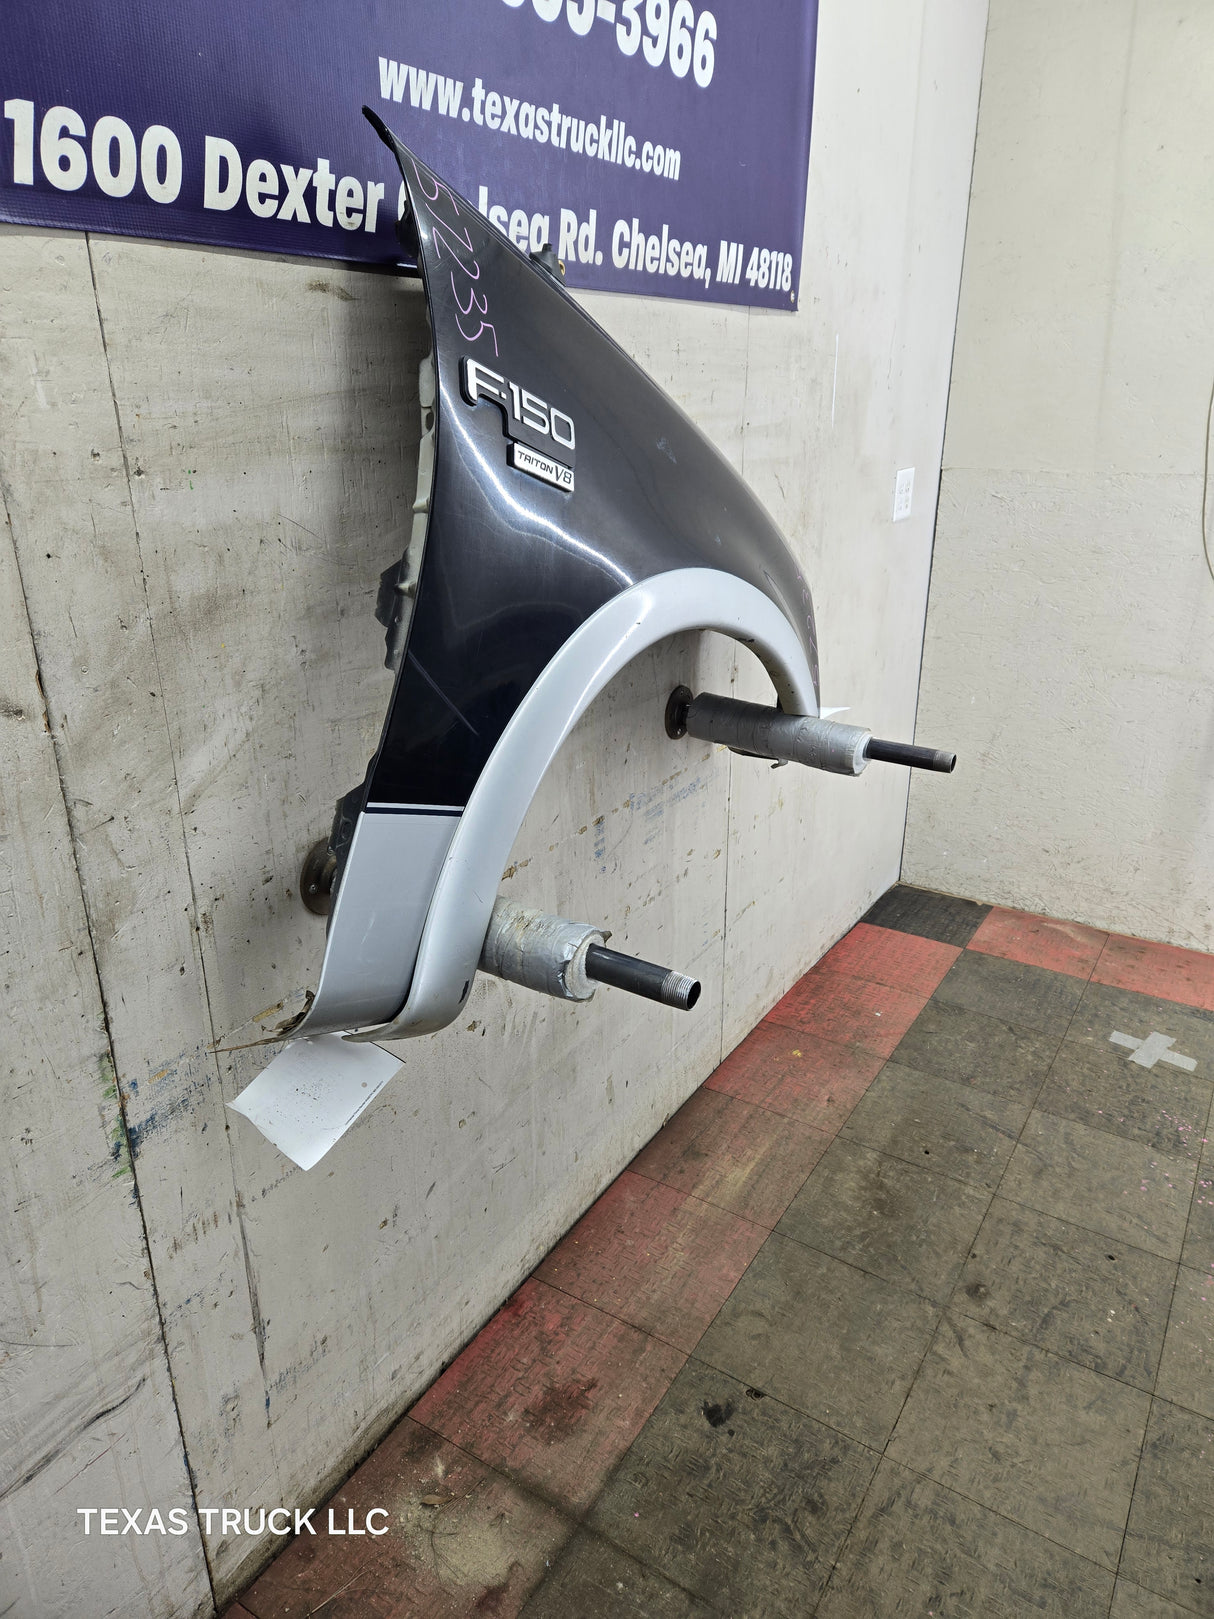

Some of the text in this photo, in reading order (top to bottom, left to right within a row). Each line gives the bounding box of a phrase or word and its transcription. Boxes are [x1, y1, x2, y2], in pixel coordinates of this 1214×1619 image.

[500, 0, 718, 88] -3966
[378, 56, 681, 181] www.texastruckllc.com
[4, 98, 183, 204] 1600
[203, 135, 385, 233] Dexter
[559, 208, 604, 265] Rd.
[611, 218, 711, 288] Chelsea,
[716, 240, 743, 284] MI
[746, 246, 793, 292] 48118
[467, 358, 576, 450] F-150
[518, 450, 573, 485] TRITON V8
